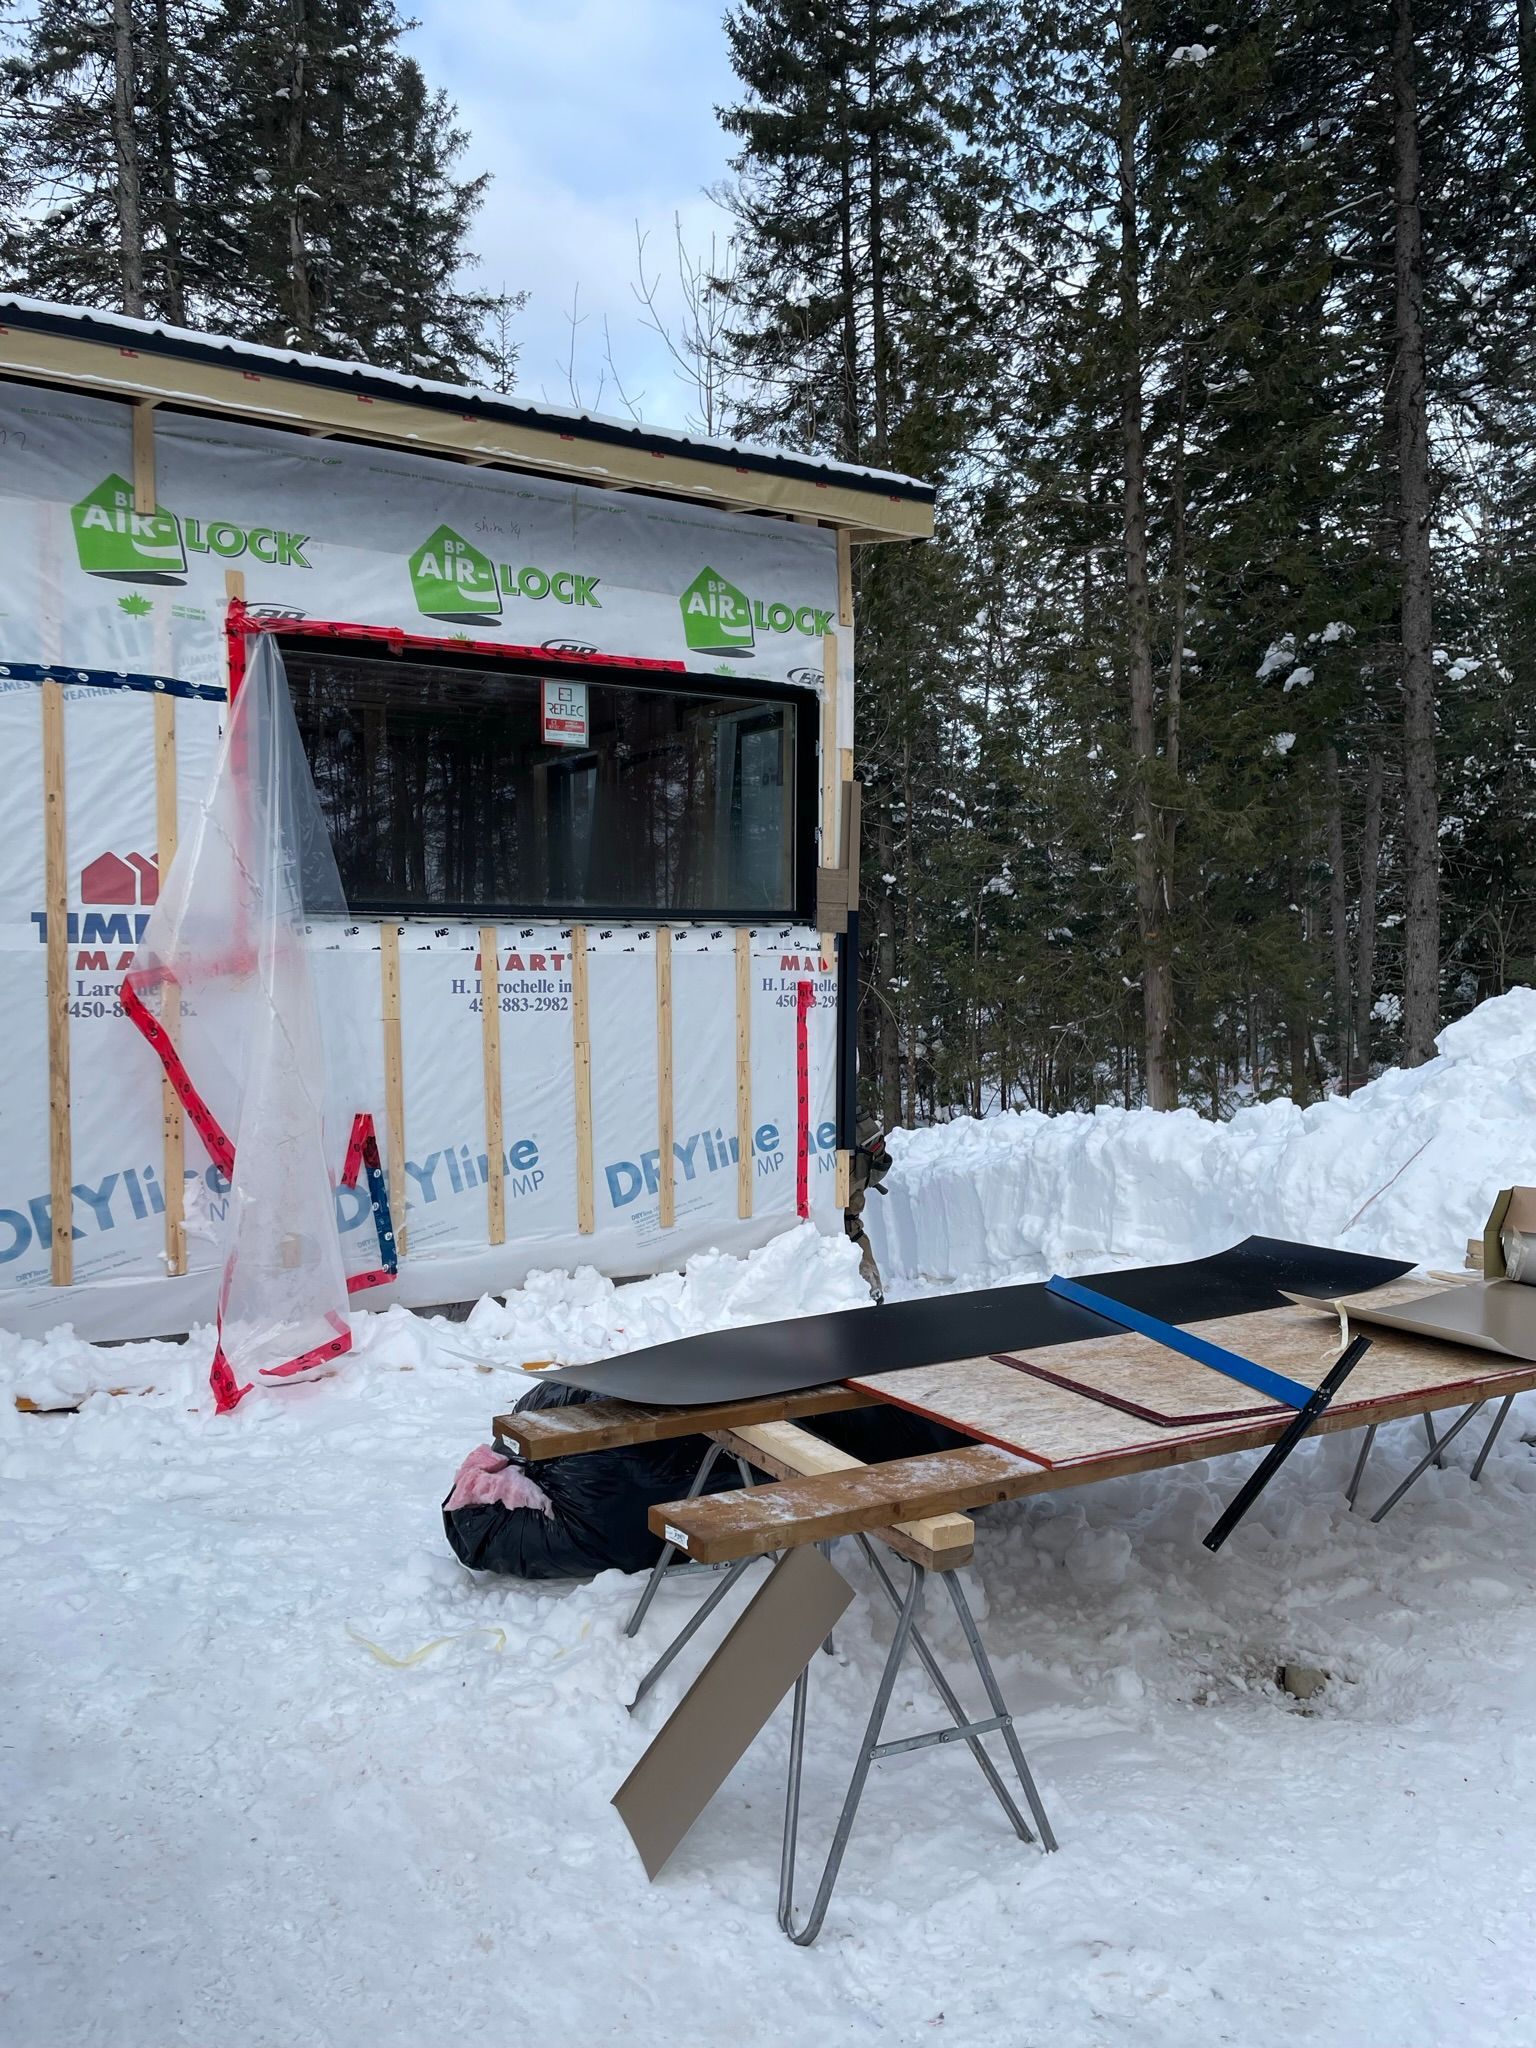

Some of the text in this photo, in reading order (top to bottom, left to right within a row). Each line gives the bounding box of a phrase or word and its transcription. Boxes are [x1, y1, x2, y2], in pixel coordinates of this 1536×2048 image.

[444, 540, 465, 554] BP
[708, 580, 726, 593] BP
[547, 702, 583, 717] REFLEC
[435, 928, 449, 938] 3M
[520, 928, 534, 939] 3M
[600, 930, 613, 940] 3M
[638, 931, 650, 941] 3M
[675, 931, 687, 941] 3M
[711, 930, 723, 941] 3M
[452, 979, 471, 994] H.
[762, 978, 778, 991] H.
[469, 997, 568, 1012] 45-883-2982
[757, 1151, 784, 1177] MP
[513, 1169, 544, 1198] MP
